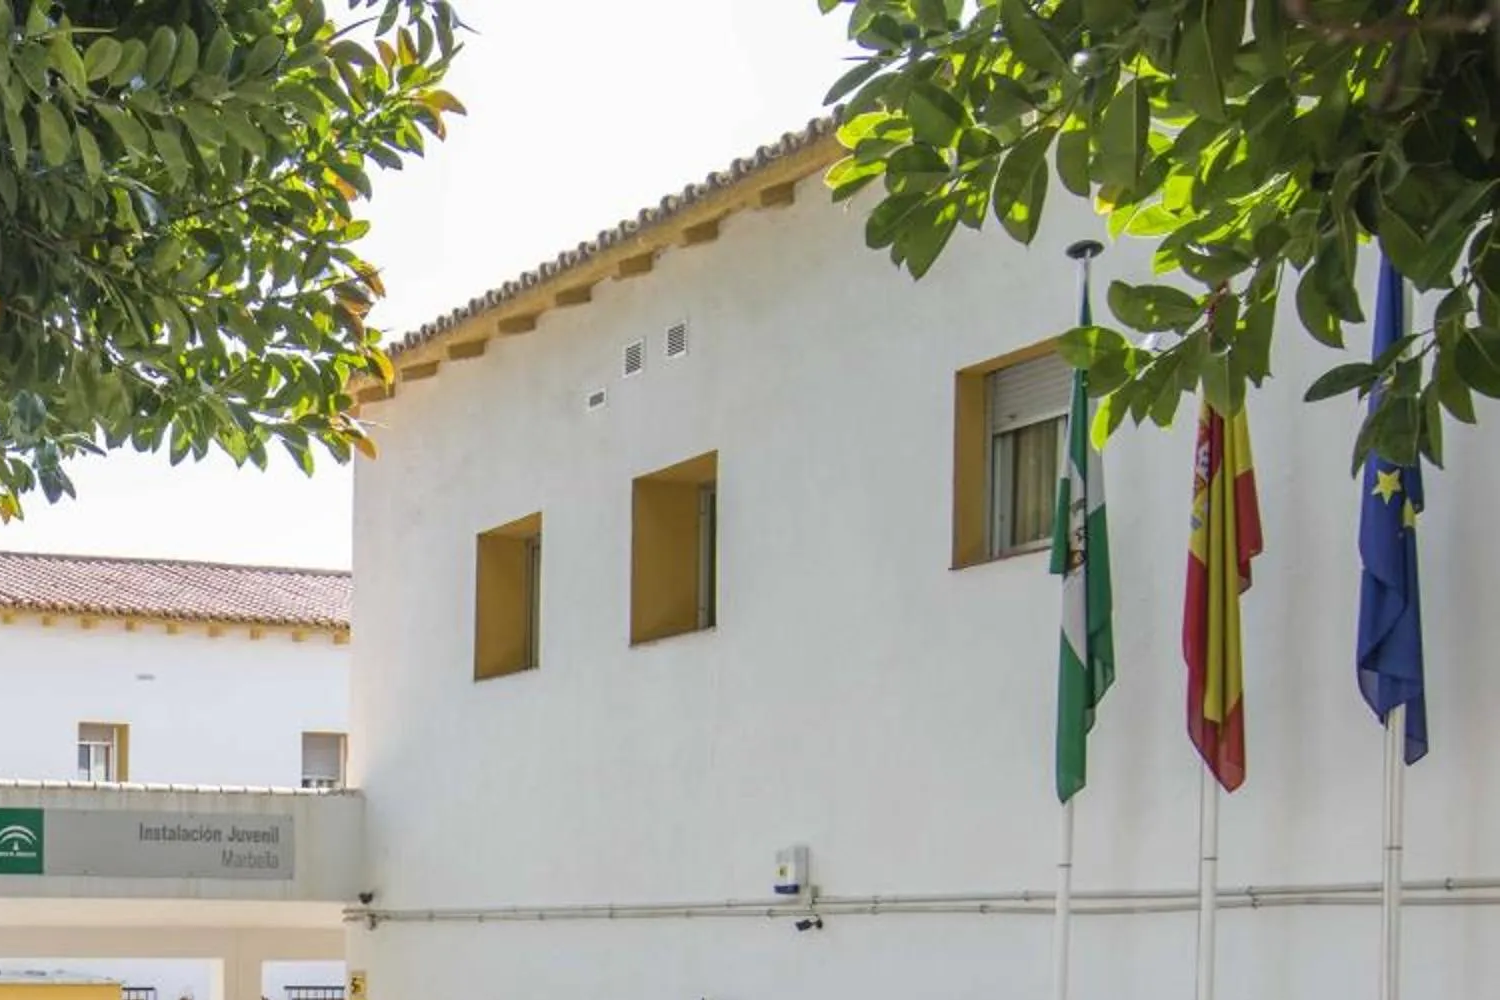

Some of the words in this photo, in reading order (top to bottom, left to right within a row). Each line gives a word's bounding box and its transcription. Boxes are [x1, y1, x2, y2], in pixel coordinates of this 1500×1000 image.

[139, 822, 222, 842] Instalación
[227, 825, 280, 844] Juvenil
[221, 849, 280, 869] Marbella
